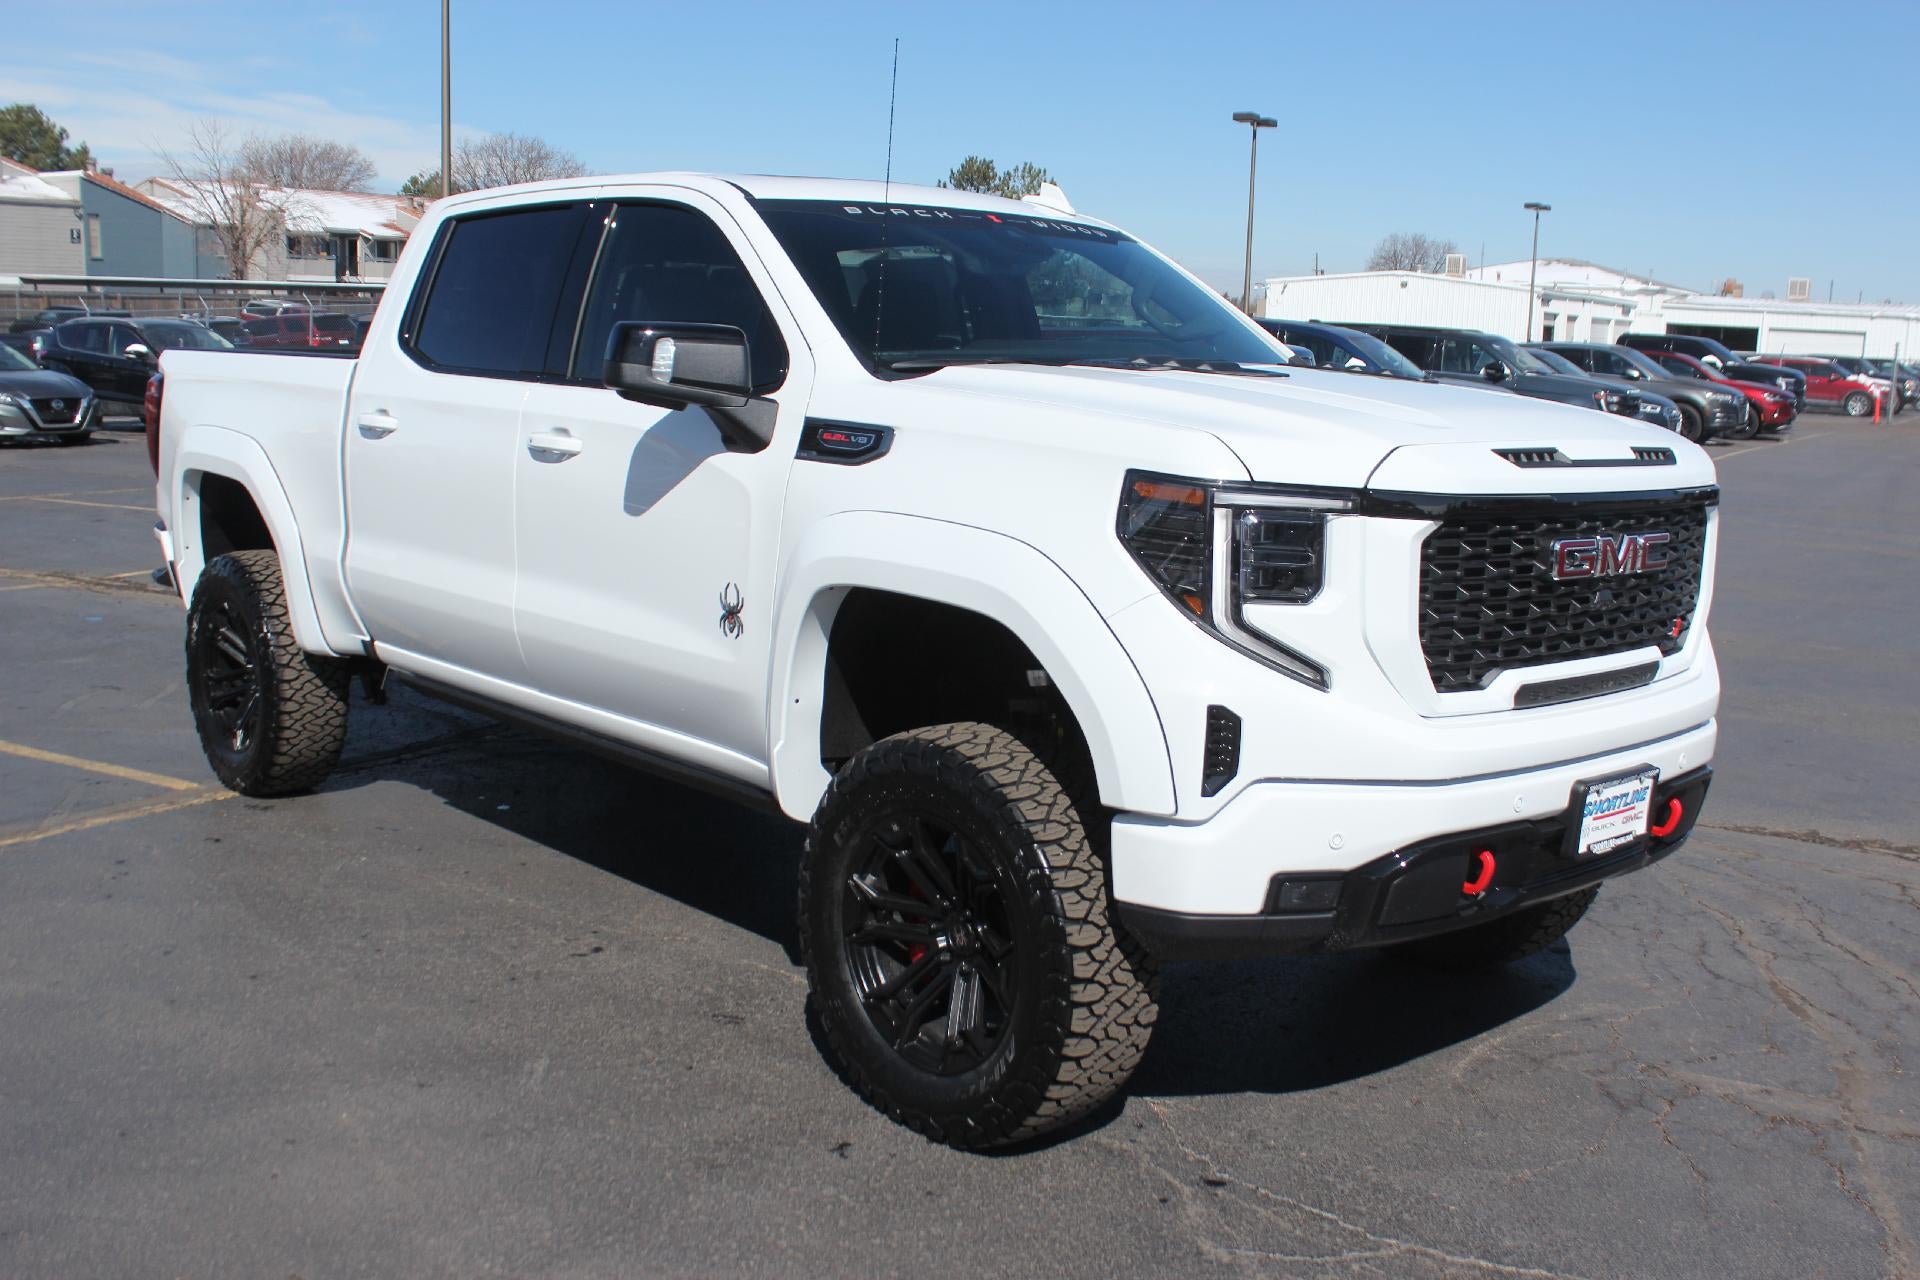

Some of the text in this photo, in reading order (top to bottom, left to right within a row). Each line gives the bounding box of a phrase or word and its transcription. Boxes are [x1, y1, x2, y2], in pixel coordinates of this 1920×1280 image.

[842, 206, 953, 219] BLACK
[850, 435, 868, 444] V8
[1551, 531, 1670, 580] GMC
[1583, 785, 1650, 818] SHORTLINE
[1591, 810, 1644, 833] BUICK GMC
